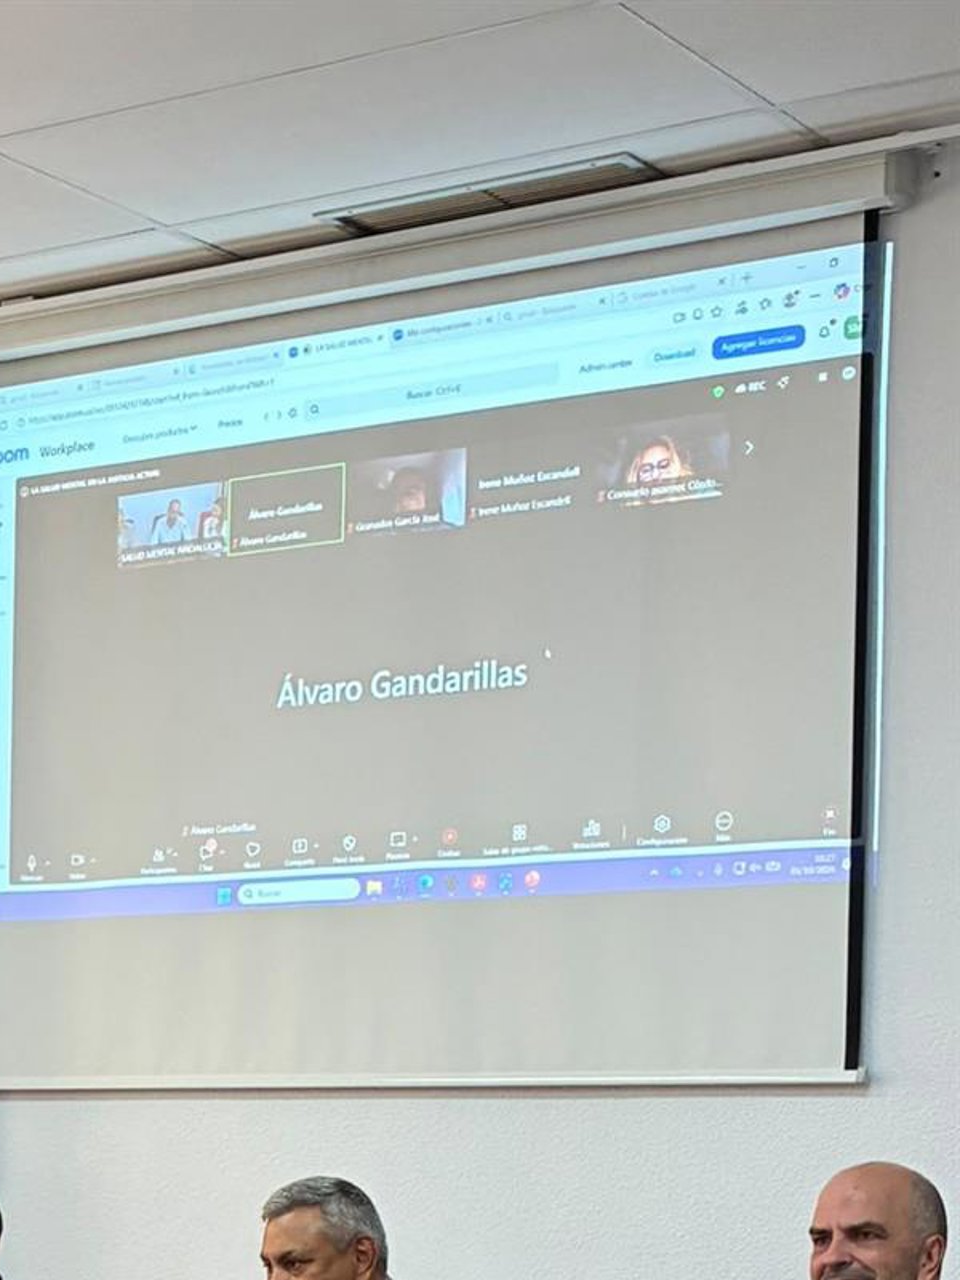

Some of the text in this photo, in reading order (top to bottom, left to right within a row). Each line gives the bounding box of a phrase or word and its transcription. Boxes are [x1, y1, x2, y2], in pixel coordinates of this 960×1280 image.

[39, 440, 95, 457] Workplace
[276, 660, 529, 709] Álvaro Gandarillas
